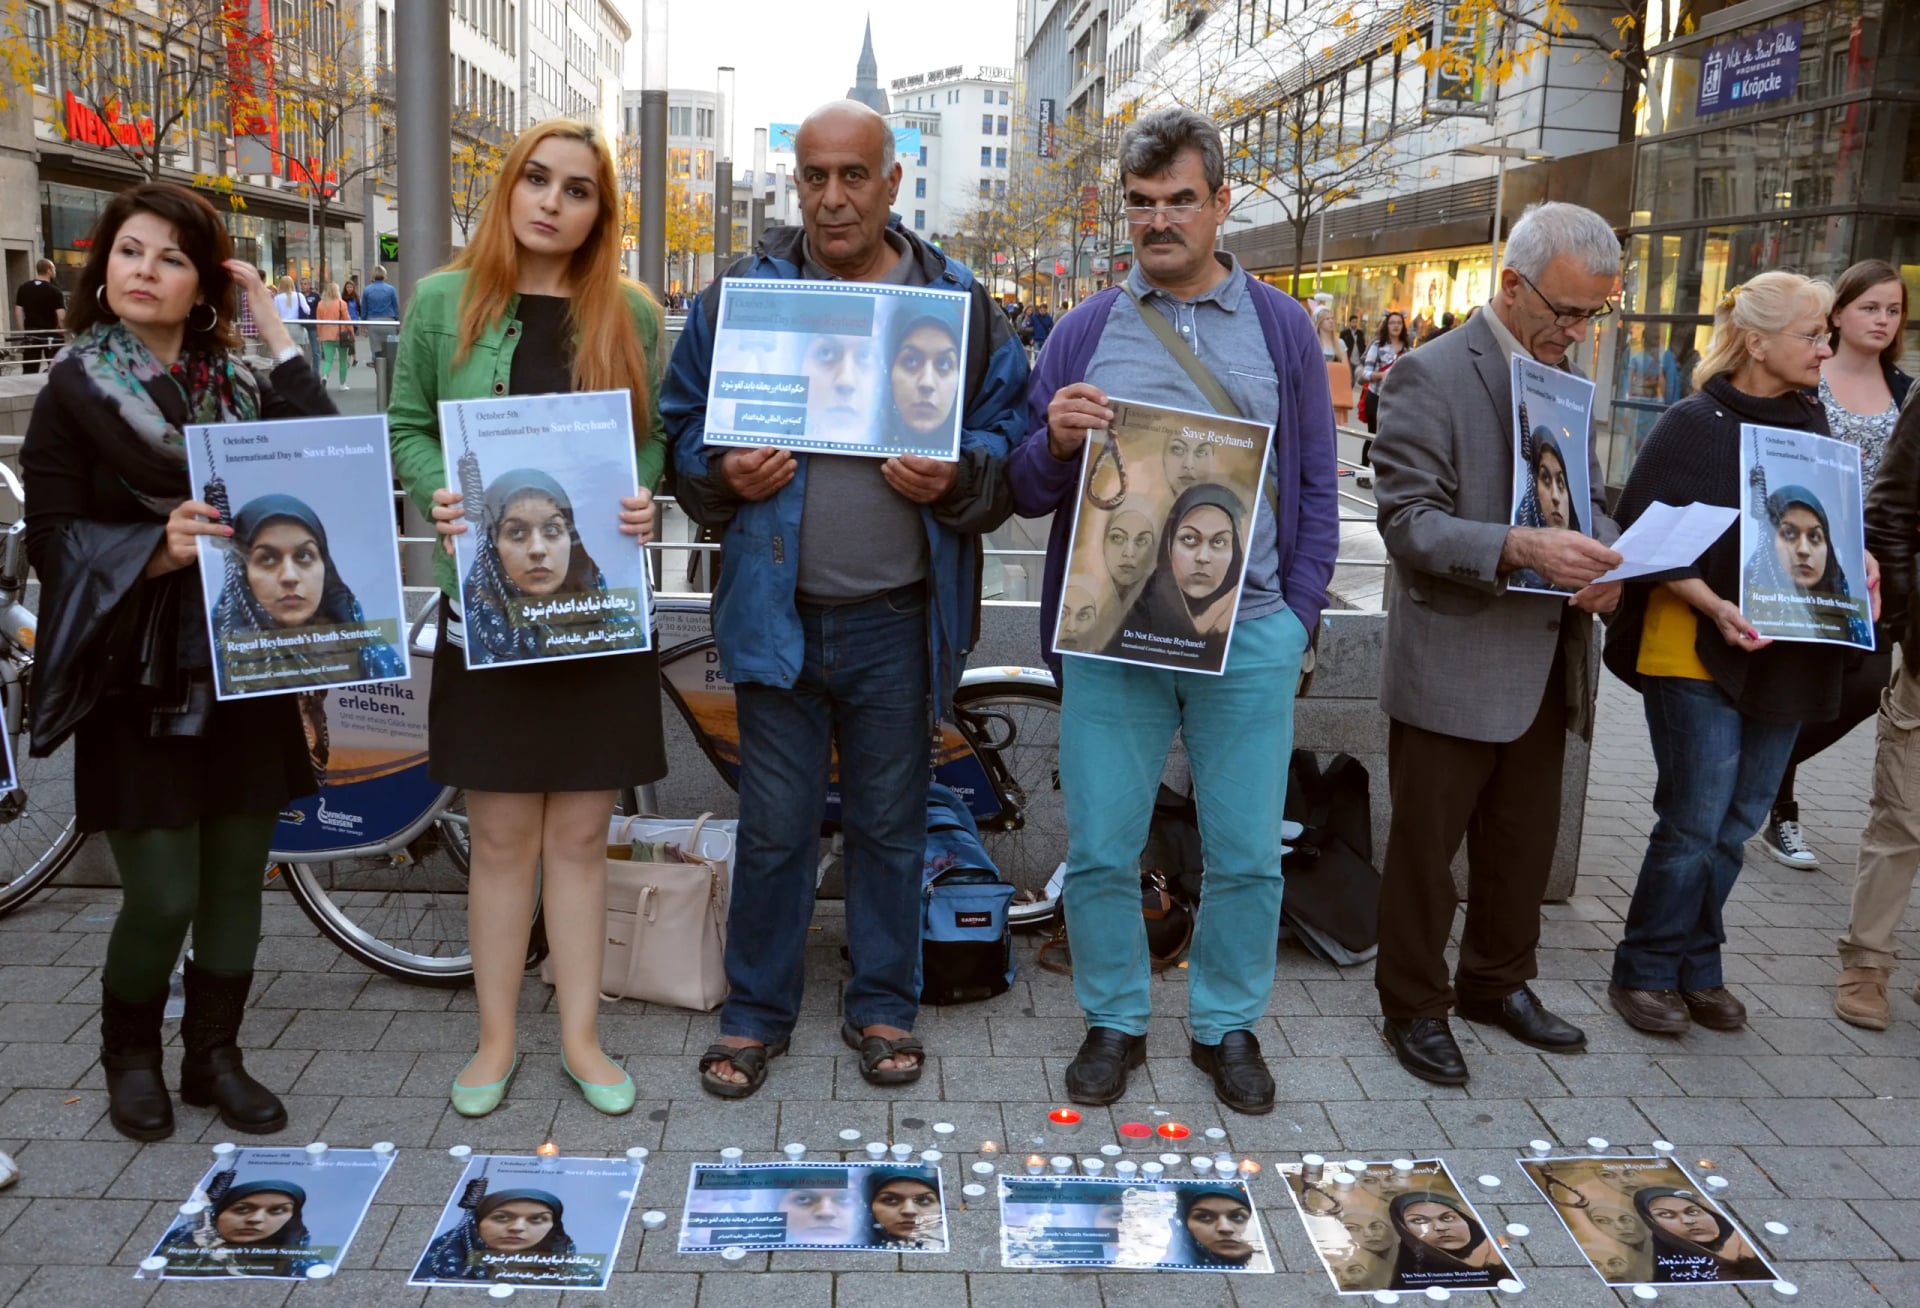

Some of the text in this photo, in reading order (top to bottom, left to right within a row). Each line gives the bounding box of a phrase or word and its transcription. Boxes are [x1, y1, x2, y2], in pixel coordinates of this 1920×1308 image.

[1736, 58, 1781, 75] PROMENADE
[1741, 71, 1782, 99] Kröpcke
[475, 410, 519, 421] October 5th
[478, 426, 525, 438] International
[526, 425, 542, 436] Day
[550, 422, 572, 433] Save
[1182, 426, 1206, 440] Save
[1207, 430, 1254, 449] Reyhaneh
[223, 434, 269, 446] October 5th
[225, 451, 275, 463] International
[277, 451, 293, 462] Day
[303, 446, 326, 458] Save
[327, 443, 375, 459] Reyhaneh
[522, 594, 636, 621] ریحانه نباید اعدام شود
[227, 626, 382, 653] Repeal Reyhaneh's Death Sentence!
[545, 634, 567, 648] اعدام
[616, 627, 636, 640] کمیته
[1123, 629, 1207, 649] Do Not Execute Reyhaneh!
[338, 683, 415, 700] dafrika
[339, 696, 405, 716] erleben.
[339, 711, 354, 720] Und
[367, 716, 386, 725] etwas
[387, 717, 406, 727] Glück
[407, 722, 421, 730] eine
[341, 719, 351, 728] für
[366, 725, 388, 734] Person
[328, 818, 353, 829] REISEN
[482, 1253, 600, 1267] ریحانه نباید اعدام شود
